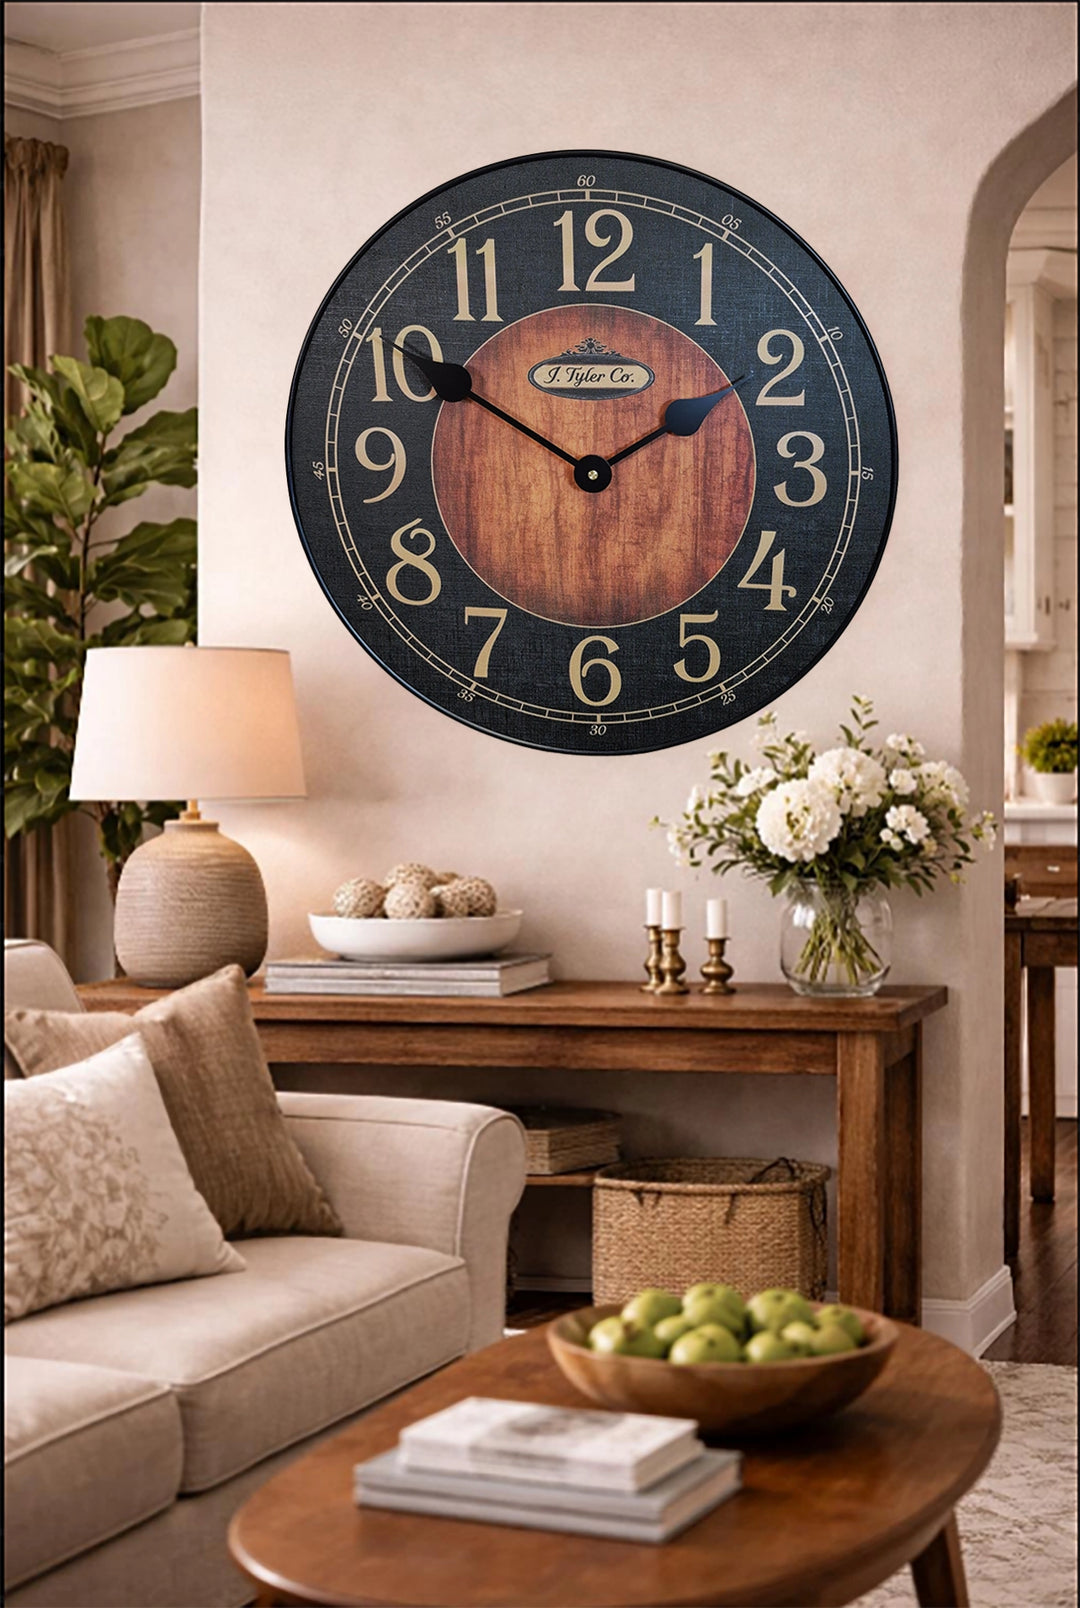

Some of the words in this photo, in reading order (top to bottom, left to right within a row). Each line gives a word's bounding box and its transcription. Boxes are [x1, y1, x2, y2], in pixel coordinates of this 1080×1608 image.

[576, 174, 596, 188] 60
[434, 211, 453, 230] 55
[720, 213, 743, 231] 05
[552, 208, 636, 293] 12
[446, 237, 505, 323] 11
[692, 242, 718, 326] 1
[337, 318, 354, 339] 50
[827, 325, 844, 342] 10
[365, 324, 446, 403] 10
[755, 328, 806, 407] 2
[565, 366, 606, 387] Tyler
[609, 366, 636, 384] Co.
[312, 461, 325, 481] 45
[354, 426, 407, 504] 9
[773, 430, 828, 507] 3
[861, 465, 874, 481] 15
[385, 517, 442, 606] 8
[736, 530, 798, 612] 4
[356, 593, 374, 612] 40
[820, 596, 835, 615] 20
[464, 606, 509, 679] 7
[673, 609, 722, 683] 5
[568, 635, 623, 707] 6
[456, 688, 476, 703] 35
[720, 690, 737, 706] 25
[589, 724, 607, 737] 30
